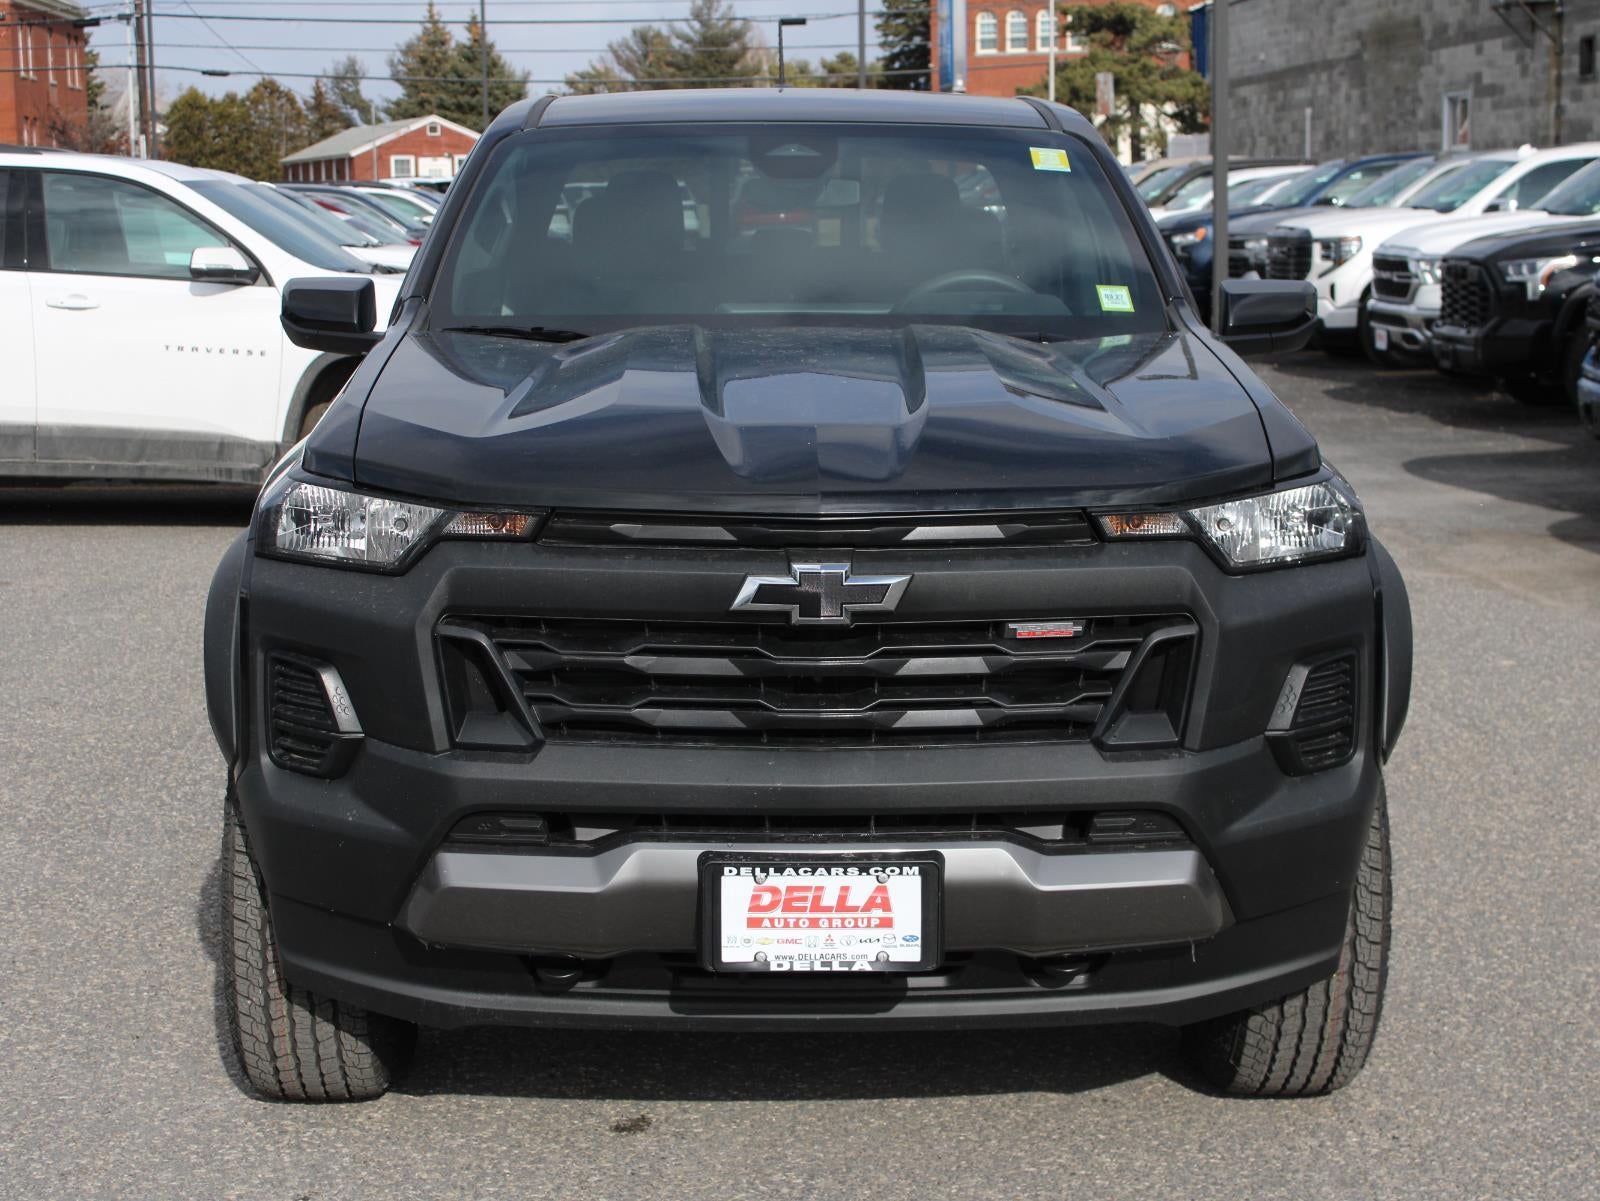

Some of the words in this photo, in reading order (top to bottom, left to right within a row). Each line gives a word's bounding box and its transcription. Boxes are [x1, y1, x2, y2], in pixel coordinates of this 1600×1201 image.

[163, 345, 267, 357] TRAVERSE
[723, 866, 920, 876] DELLACARS.COM
[748, 885, 893, 913] DELLA
[761, 918, 808, 928] AUTO
[819, 918, 881, 928] GROUP
[770, 960, 873, 971] DELLA
